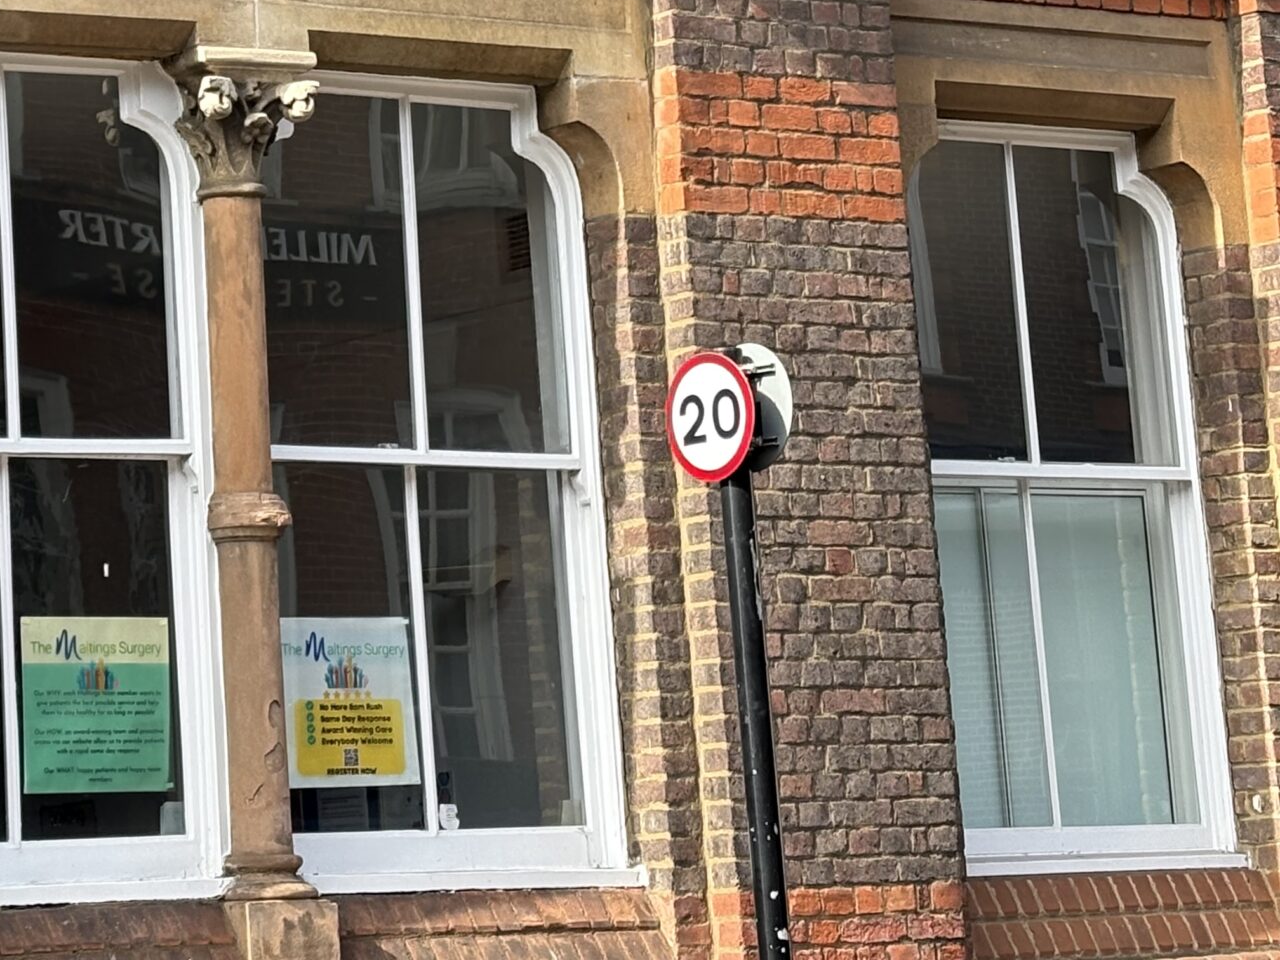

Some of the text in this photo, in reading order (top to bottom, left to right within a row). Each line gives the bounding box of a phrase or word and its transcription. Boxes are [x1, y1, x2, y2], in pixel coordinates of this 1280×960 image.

[679, 388, 741, 447] 20
[30, 629, 161, 660] The Maltings Surgery
[282, 632, 405, 662] The Maltings Surgery
